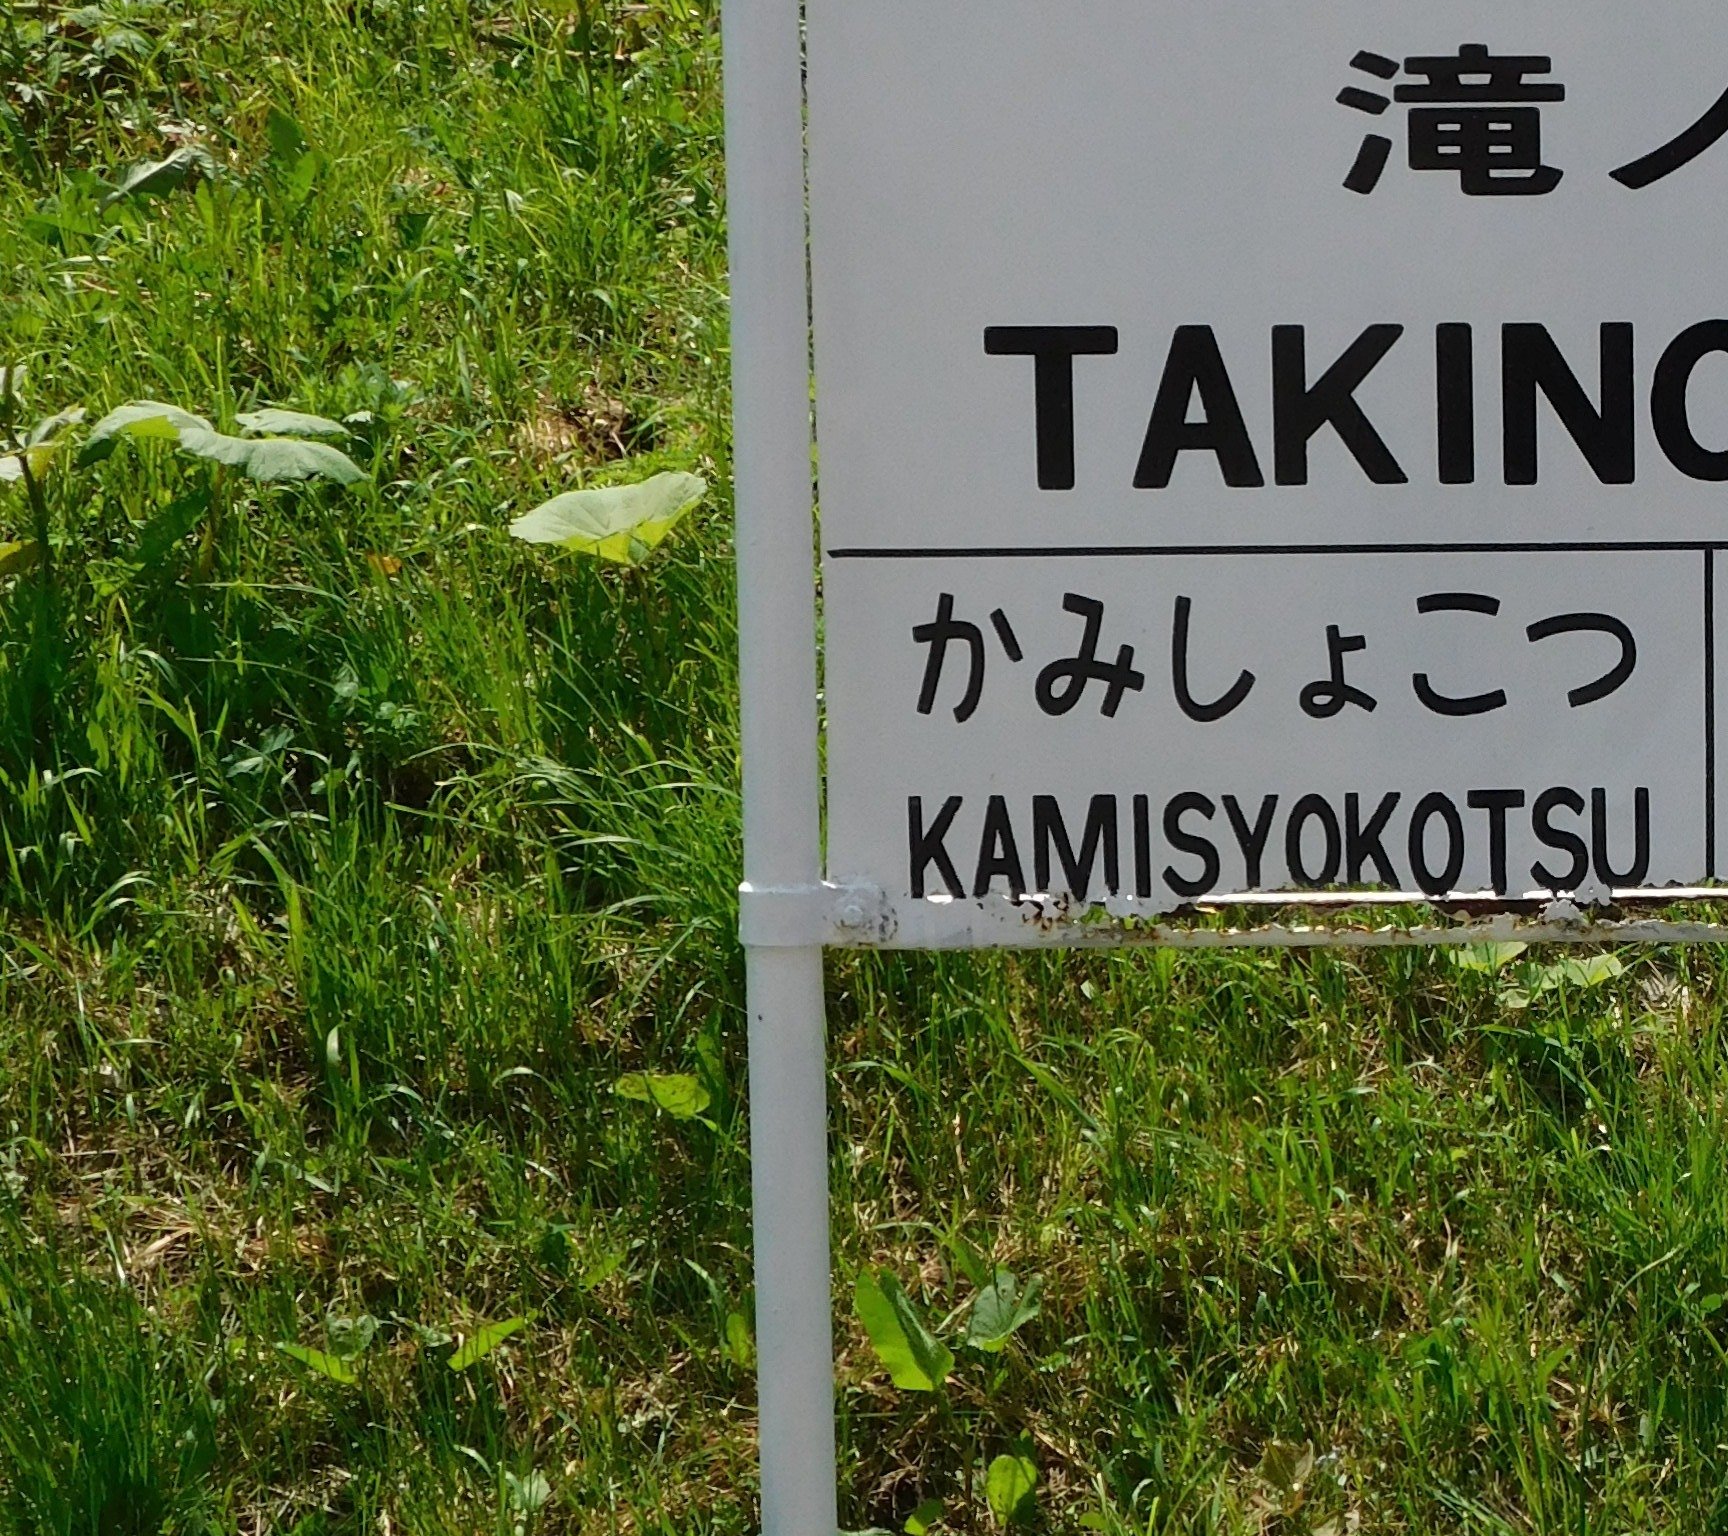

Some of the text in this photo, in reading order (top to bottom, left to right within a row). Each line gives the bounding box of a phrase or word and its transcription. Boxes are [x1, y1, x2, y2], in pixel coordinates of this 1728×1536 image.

[913, 593, 1636, 723] かみしょこつ
[908, 787, 1650, 900] KAMISYOKOTSU
